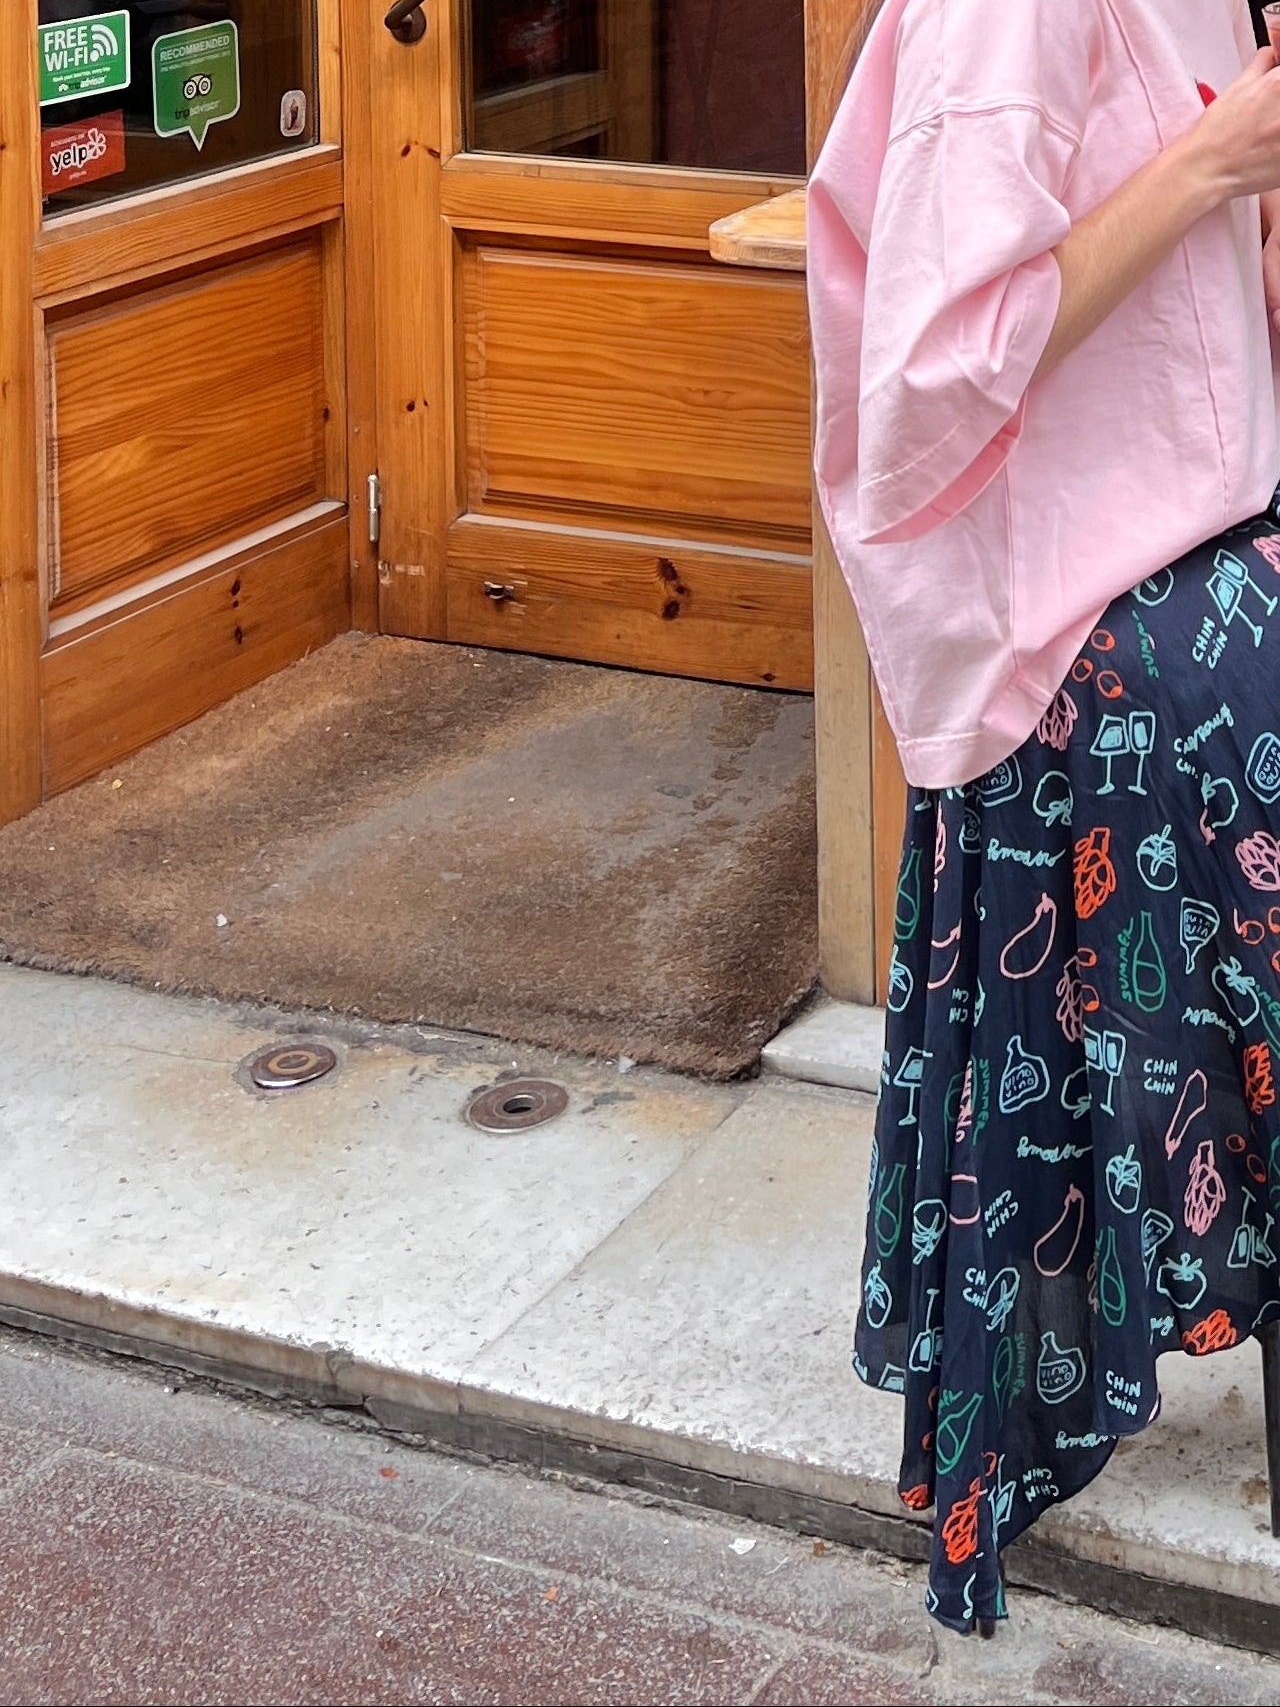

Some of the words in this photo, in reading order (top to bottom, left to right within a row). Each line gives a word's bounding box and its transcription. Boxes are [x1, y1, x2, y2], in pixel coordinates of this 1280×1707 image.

[44, 24, 88, 53] FREE
[159, 35, 231, 63] RECOMMENDED
[44, 48, 88, 72] WI-FI
[51, 144, 89, 174] yelp
[1191, 615, 1216, 663] CHIN
[1143, 1058, 1178, 1076] CHIN
[986, 1201, 1019, 1239] CHIN
[1105, 1369, 1142, 1399] CHIN
[1025, 1483, 1060, 1503] CHIN
